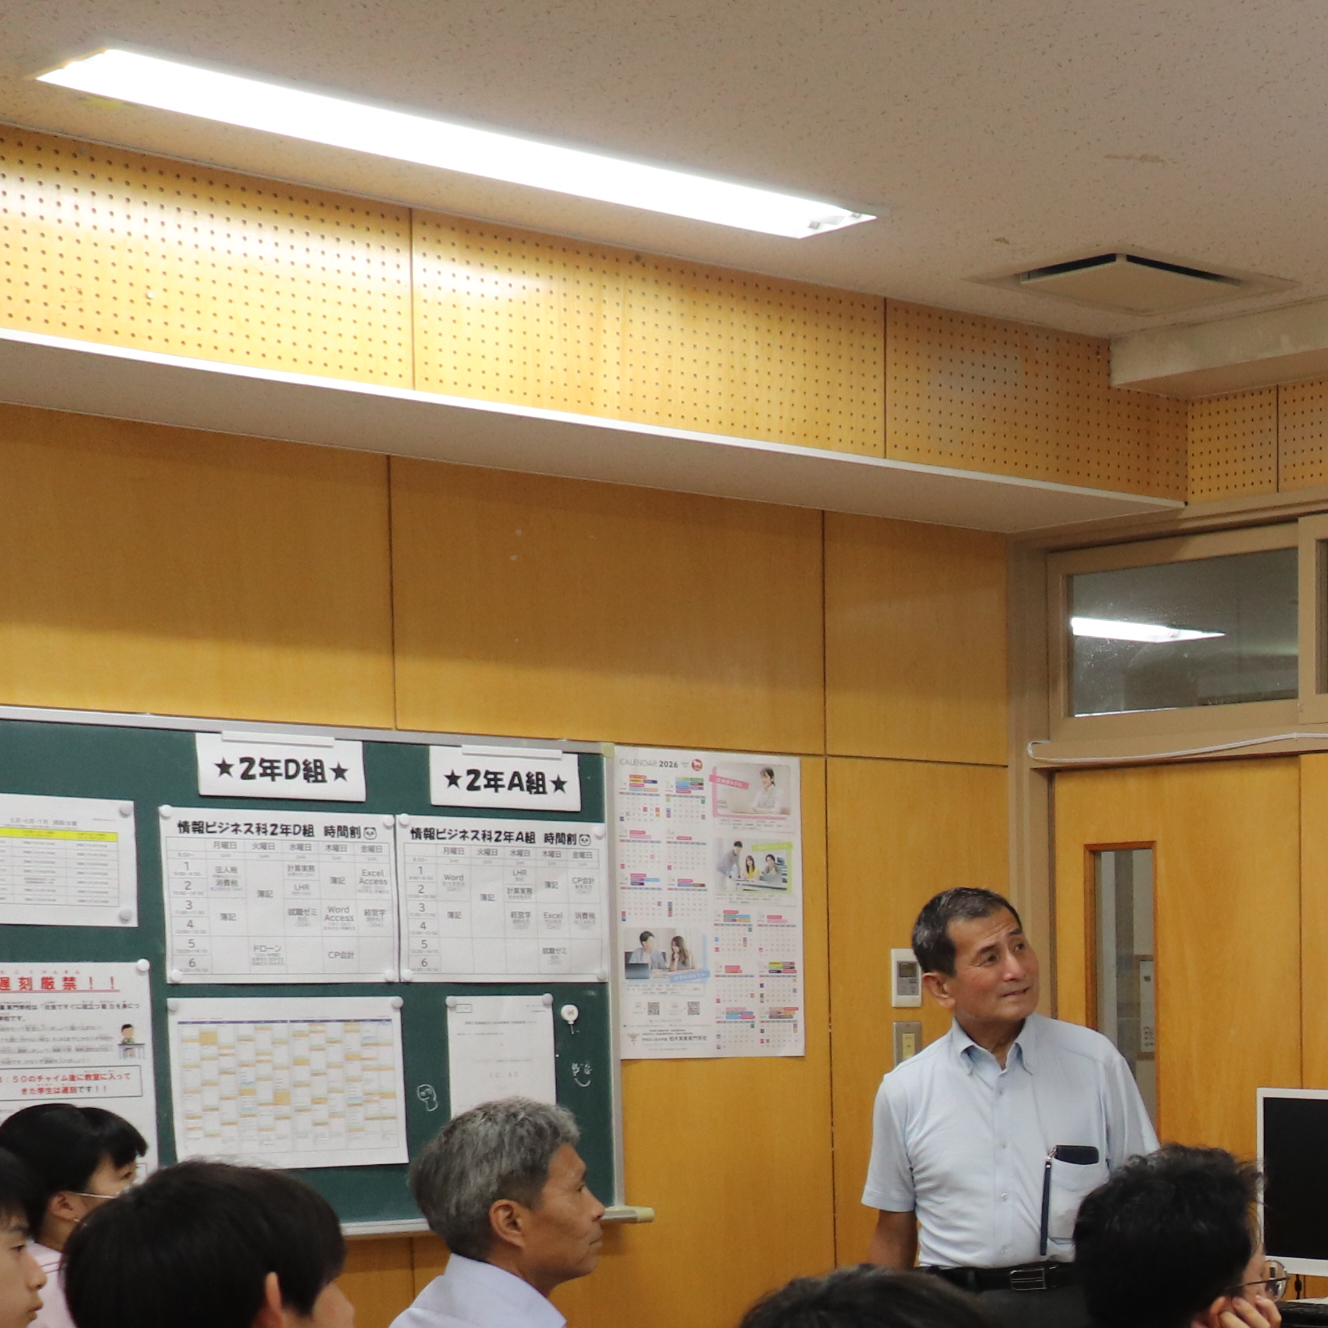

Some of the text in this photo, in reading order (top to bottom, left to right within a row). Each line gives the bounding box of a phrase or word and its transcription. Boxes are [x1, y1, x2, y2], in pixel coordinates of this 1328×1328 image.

[620, 758, 657, 766] CALENDAR
[178, 821, 361, 839] 情報ビジネス科2年D組 時間割
[410, 827, 577, 845] 情報ビジネス科2年A組 時間割
[213, 841, 237, 849] 月曜日
[252, 842, 275, 850] 火曜日
[289, 843, 312, 851] 水曜日
[325, 844, 347, 852] 木曜日
[361, 845, 383, 854] 金曜日
[444, 847, 464, 855] 月曜日
[477, 848, 498, 856] 火曜日
[510, 849, 530, 857] 水曜日
[542, 850, 561, 858] 木曜日
[572, 851, 592, 859] 金曜日
[185, 862, 189, 871] 1
[418, 866, 423, 875] 1
[362, 869, 384, 877] Excel
[330, 877, 345, 885] 簿記
[545, 881, 559, 889] 簿記
[185, 881, 191, 890] 2
[418, 885, 424, 893] 2
[257, 890, 273, 899] 簿記
[480, 894, 495, 902] 簿記
[186, 901, 192, 910] 3
[419, 903, 425, 912] 3
[327, 906, 349, 914] Word
[324, 914, 354, 922] Access
[447, 911, 462, 919] 簿記
[187, 920, 194, 929] 4
[420, 921, 426, 930] 4
[188, 939, 196, 948] 5
[421, 940, 428, 948] 5
[328, 951, 354, 959] CP会計
[189, 958, 196, 968] 6
[421, 958, 428, 967] 6
